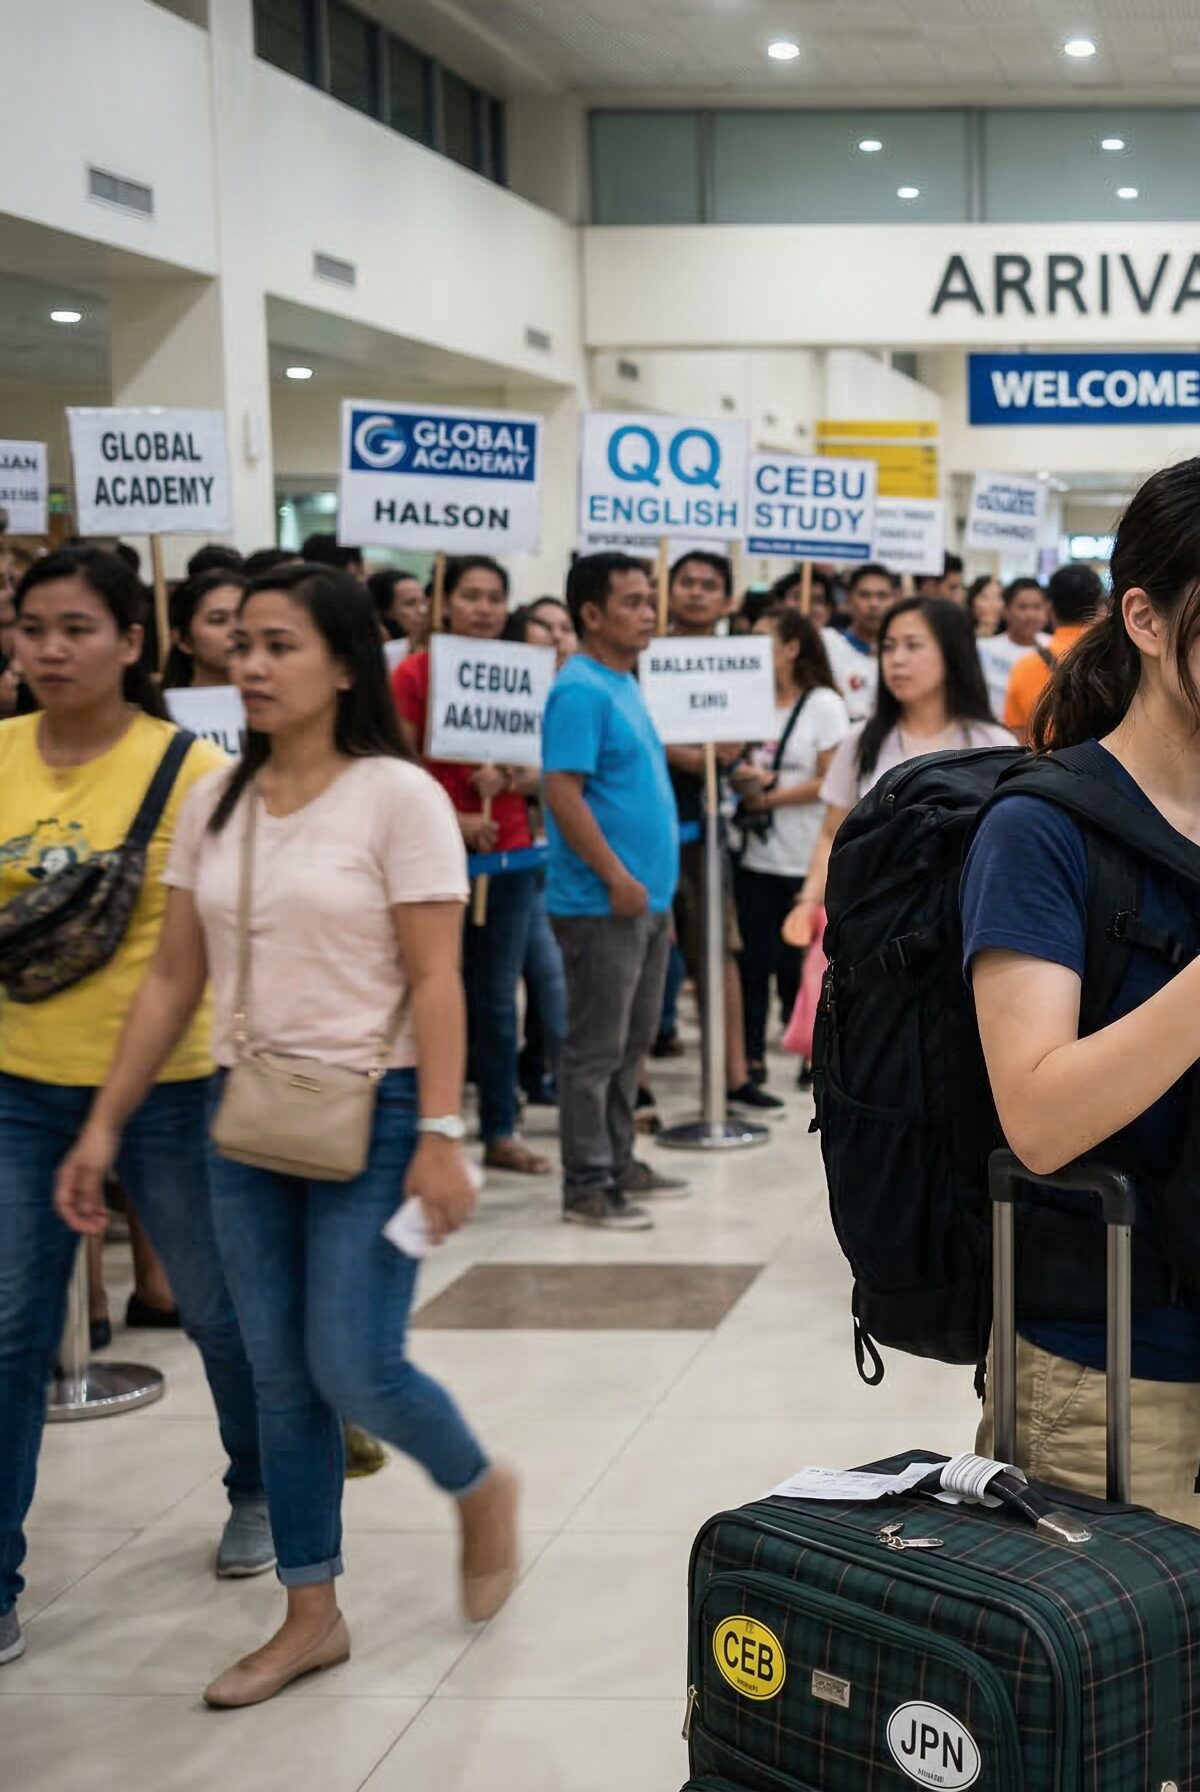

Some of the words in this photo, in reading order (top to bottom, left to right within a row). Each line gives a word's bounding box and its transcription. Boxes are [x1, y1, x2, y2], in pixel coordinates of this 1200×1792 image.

[991, 370, 1200, 408] WELCOME
[101, 431, 202, 462] GLOBAL
[413, 419, 530, 453] GLOBAL
[412, 447, 530, 476] ACADEMY
[607, 425, 721, 489] QQ
[94, 475, 215, 506] ACADEMY
[755, 464, 866, 501] CEBU
[374, 499, 510, 530] HALSON
[589, 495, 738, 528] ENGLISH
[754, 502, 865, 534] STUDY
[458, 661, 532, 696] CEBUA
[723, 1630, 774, 1682] CEB
[901, 1719, 963, 1774] JPN
